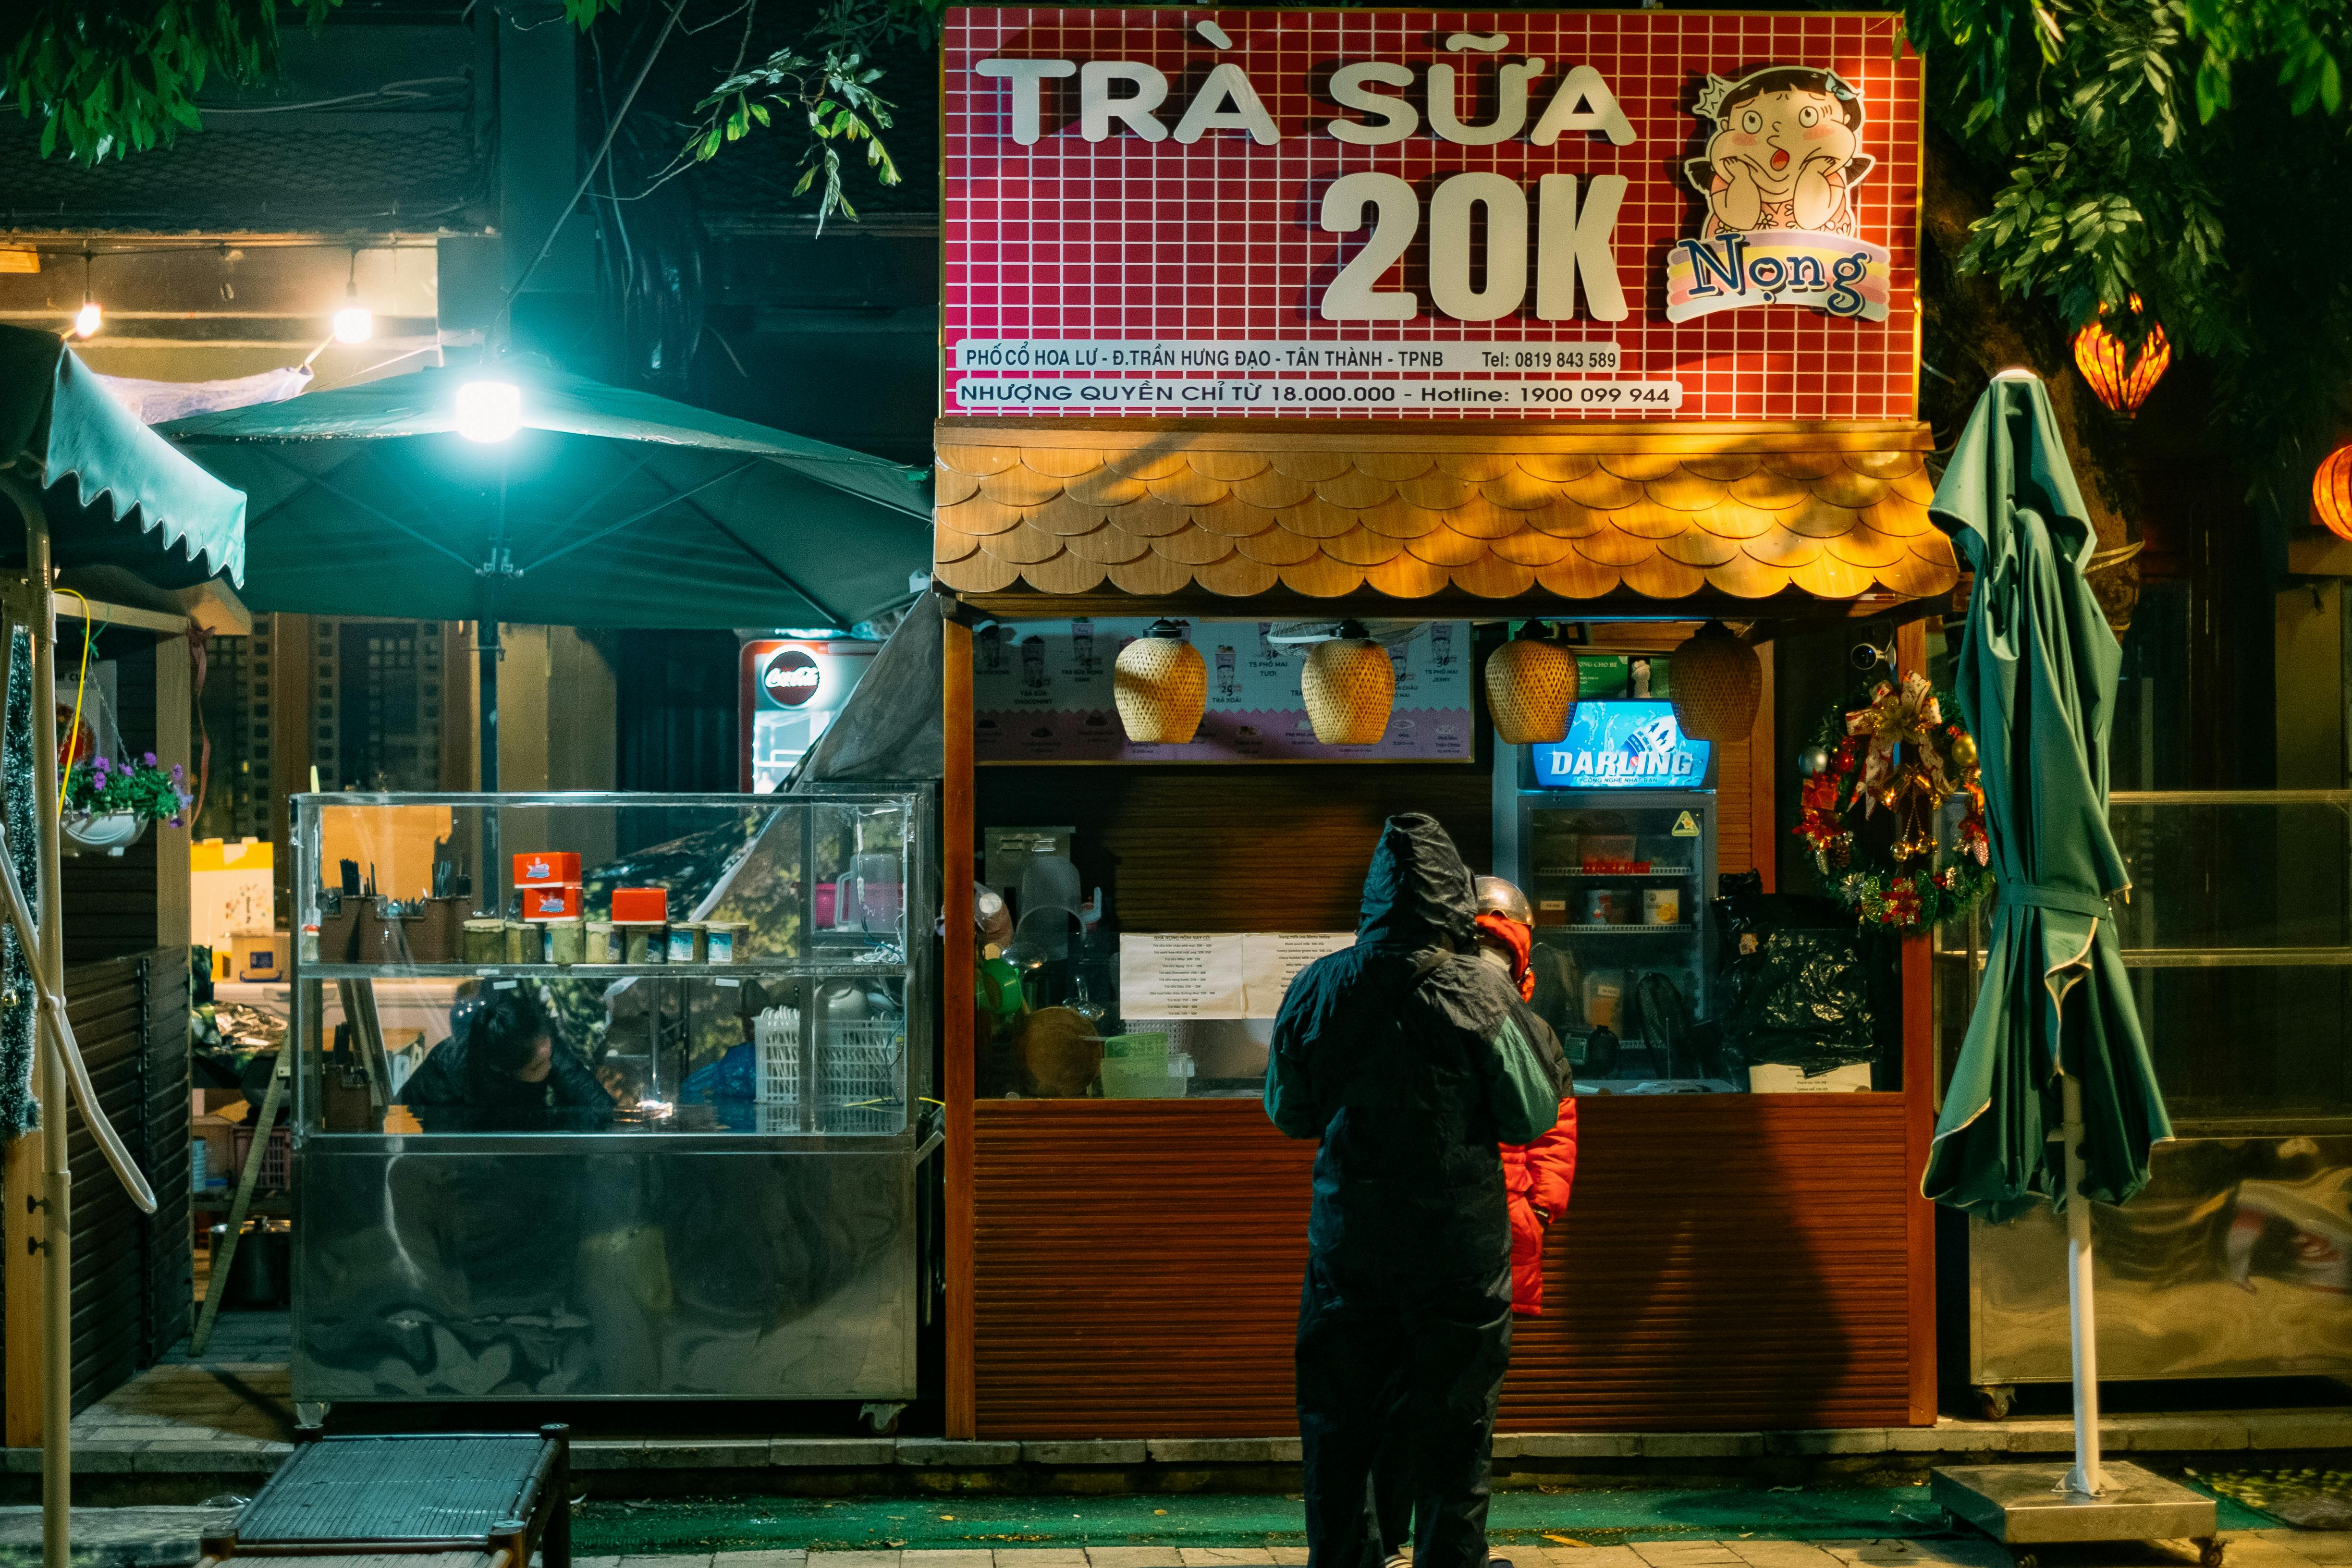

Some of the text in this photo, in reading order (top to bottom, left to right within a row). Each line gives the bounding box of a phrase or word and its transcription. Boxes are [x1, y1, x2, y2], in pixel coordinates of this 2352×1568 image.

[976, 21, 1637, 147] TRÀ SỮA
[1321, 172, 1629, 321] 20K
[1677, 233, 1872, 317] Nọng
[967, 343, 1002, 366] PHỐ
[1005, 341, 1029, 366] CỔ
[1035, 350, 1070, 366] HOA
[1076, 348, 1098, 366] LƯ
[1182, 348, 1228, 366] HƯNG
[1235, 350, 1271, 369] ĐẠO
[1286, 346, 1319, 366] TÂN
[1324, 346, 1382, 366] THÀNH
[1398, 351, 1443, 367] TPNB
[1482, 352, 1616, 368] Tel: 0819 843 589
[961, 384, 1072, 403] NHƯỢNG
[1080, 380, 1172, 400] QUYỀN
[1182, 380, 1225, 401] CHỈ
[1232, 382, 1262, 401] TỪ
[1273, 387, 1395, 402] 18.000.000
[1421, 387, 1509, 402] Hotline:
[1521, 388, 1572, 402] 1900
[1581, 388, 1621, 402] 099
[1629, 389, 1670, 402] 944
[1551, 751, 1693, 776] DARLING
